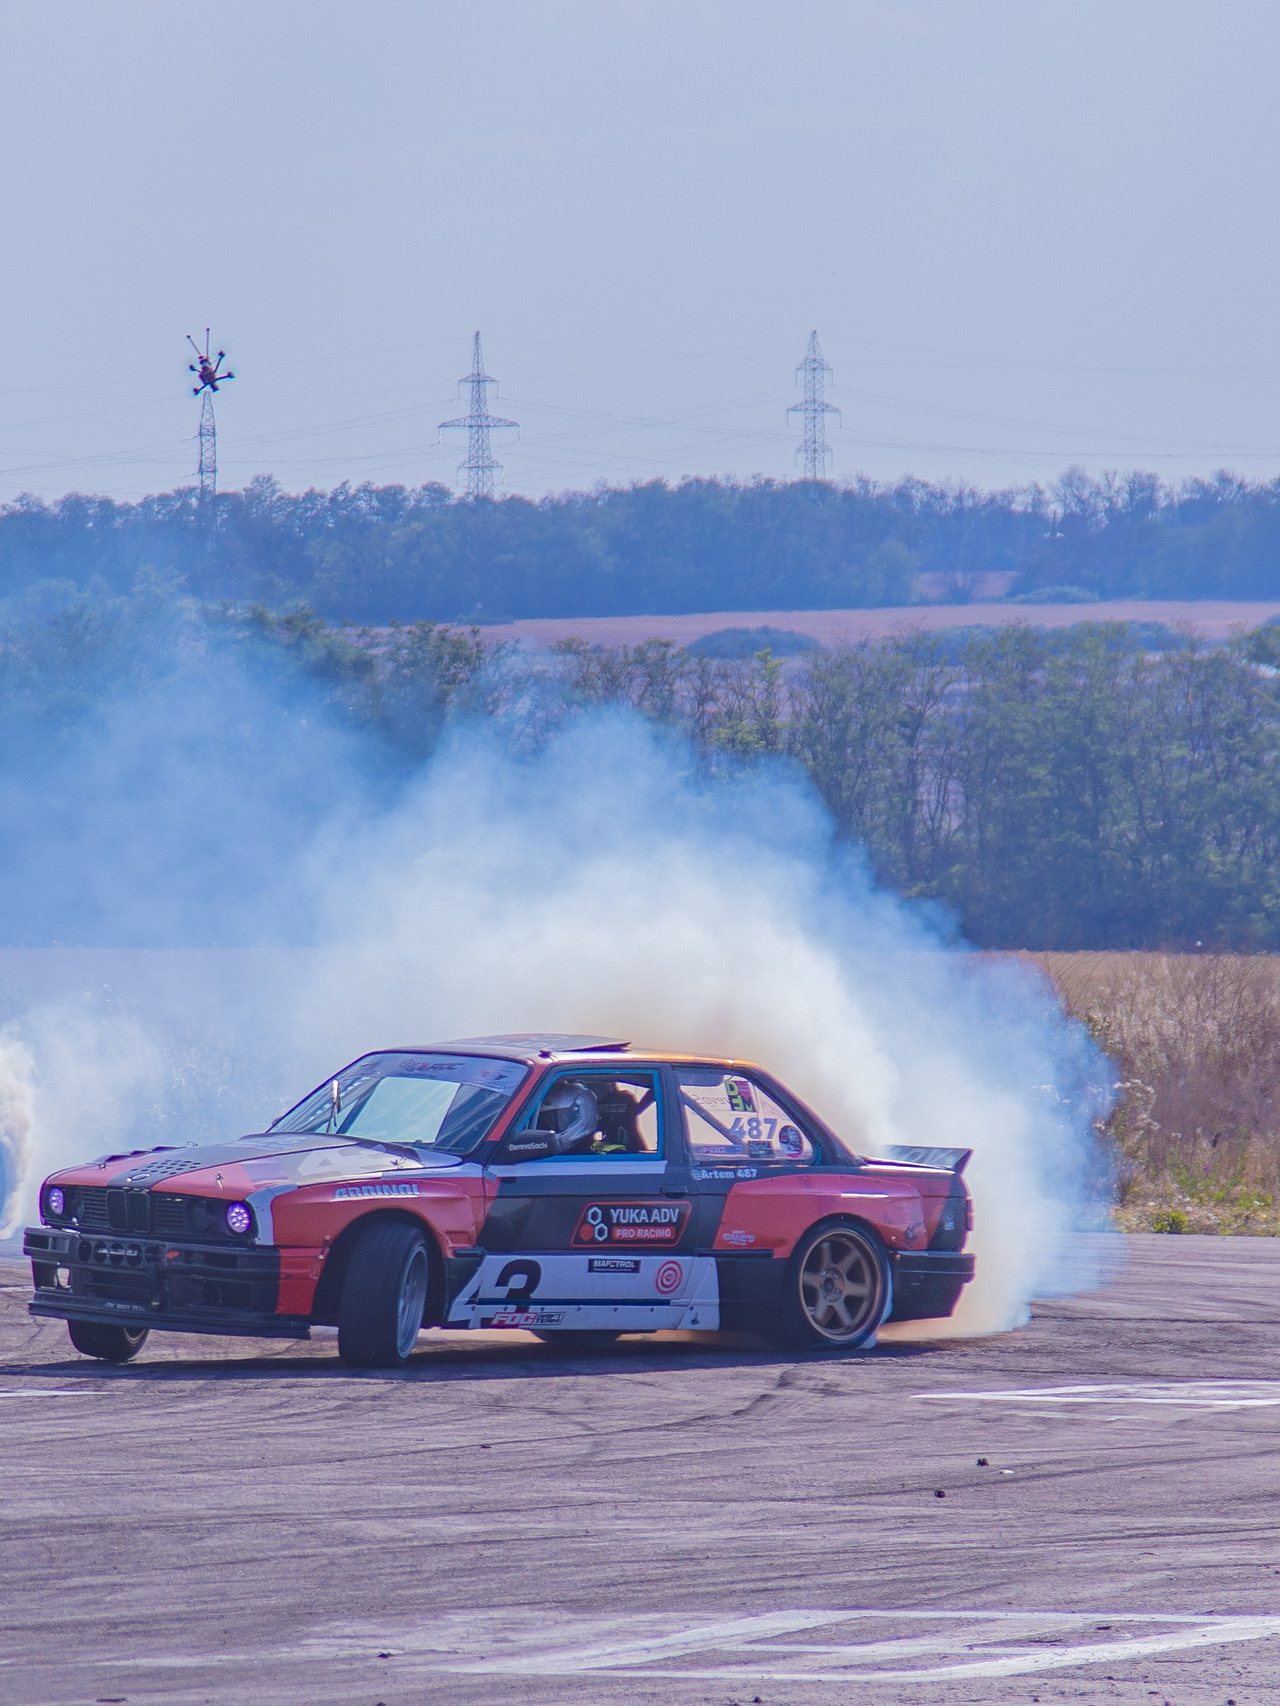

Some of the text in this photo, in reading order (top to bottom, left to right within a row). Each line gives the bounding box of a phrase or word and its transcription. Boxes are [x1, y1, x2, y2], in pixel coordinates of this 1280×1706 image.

[729, 1117, 778, 1140] 487
[691, 1168, 758, 1181] @Artem 487
[610, 1208, 680, 1223] YUKA ADV
[616, 1228, 672, 1238] PRO RACING
